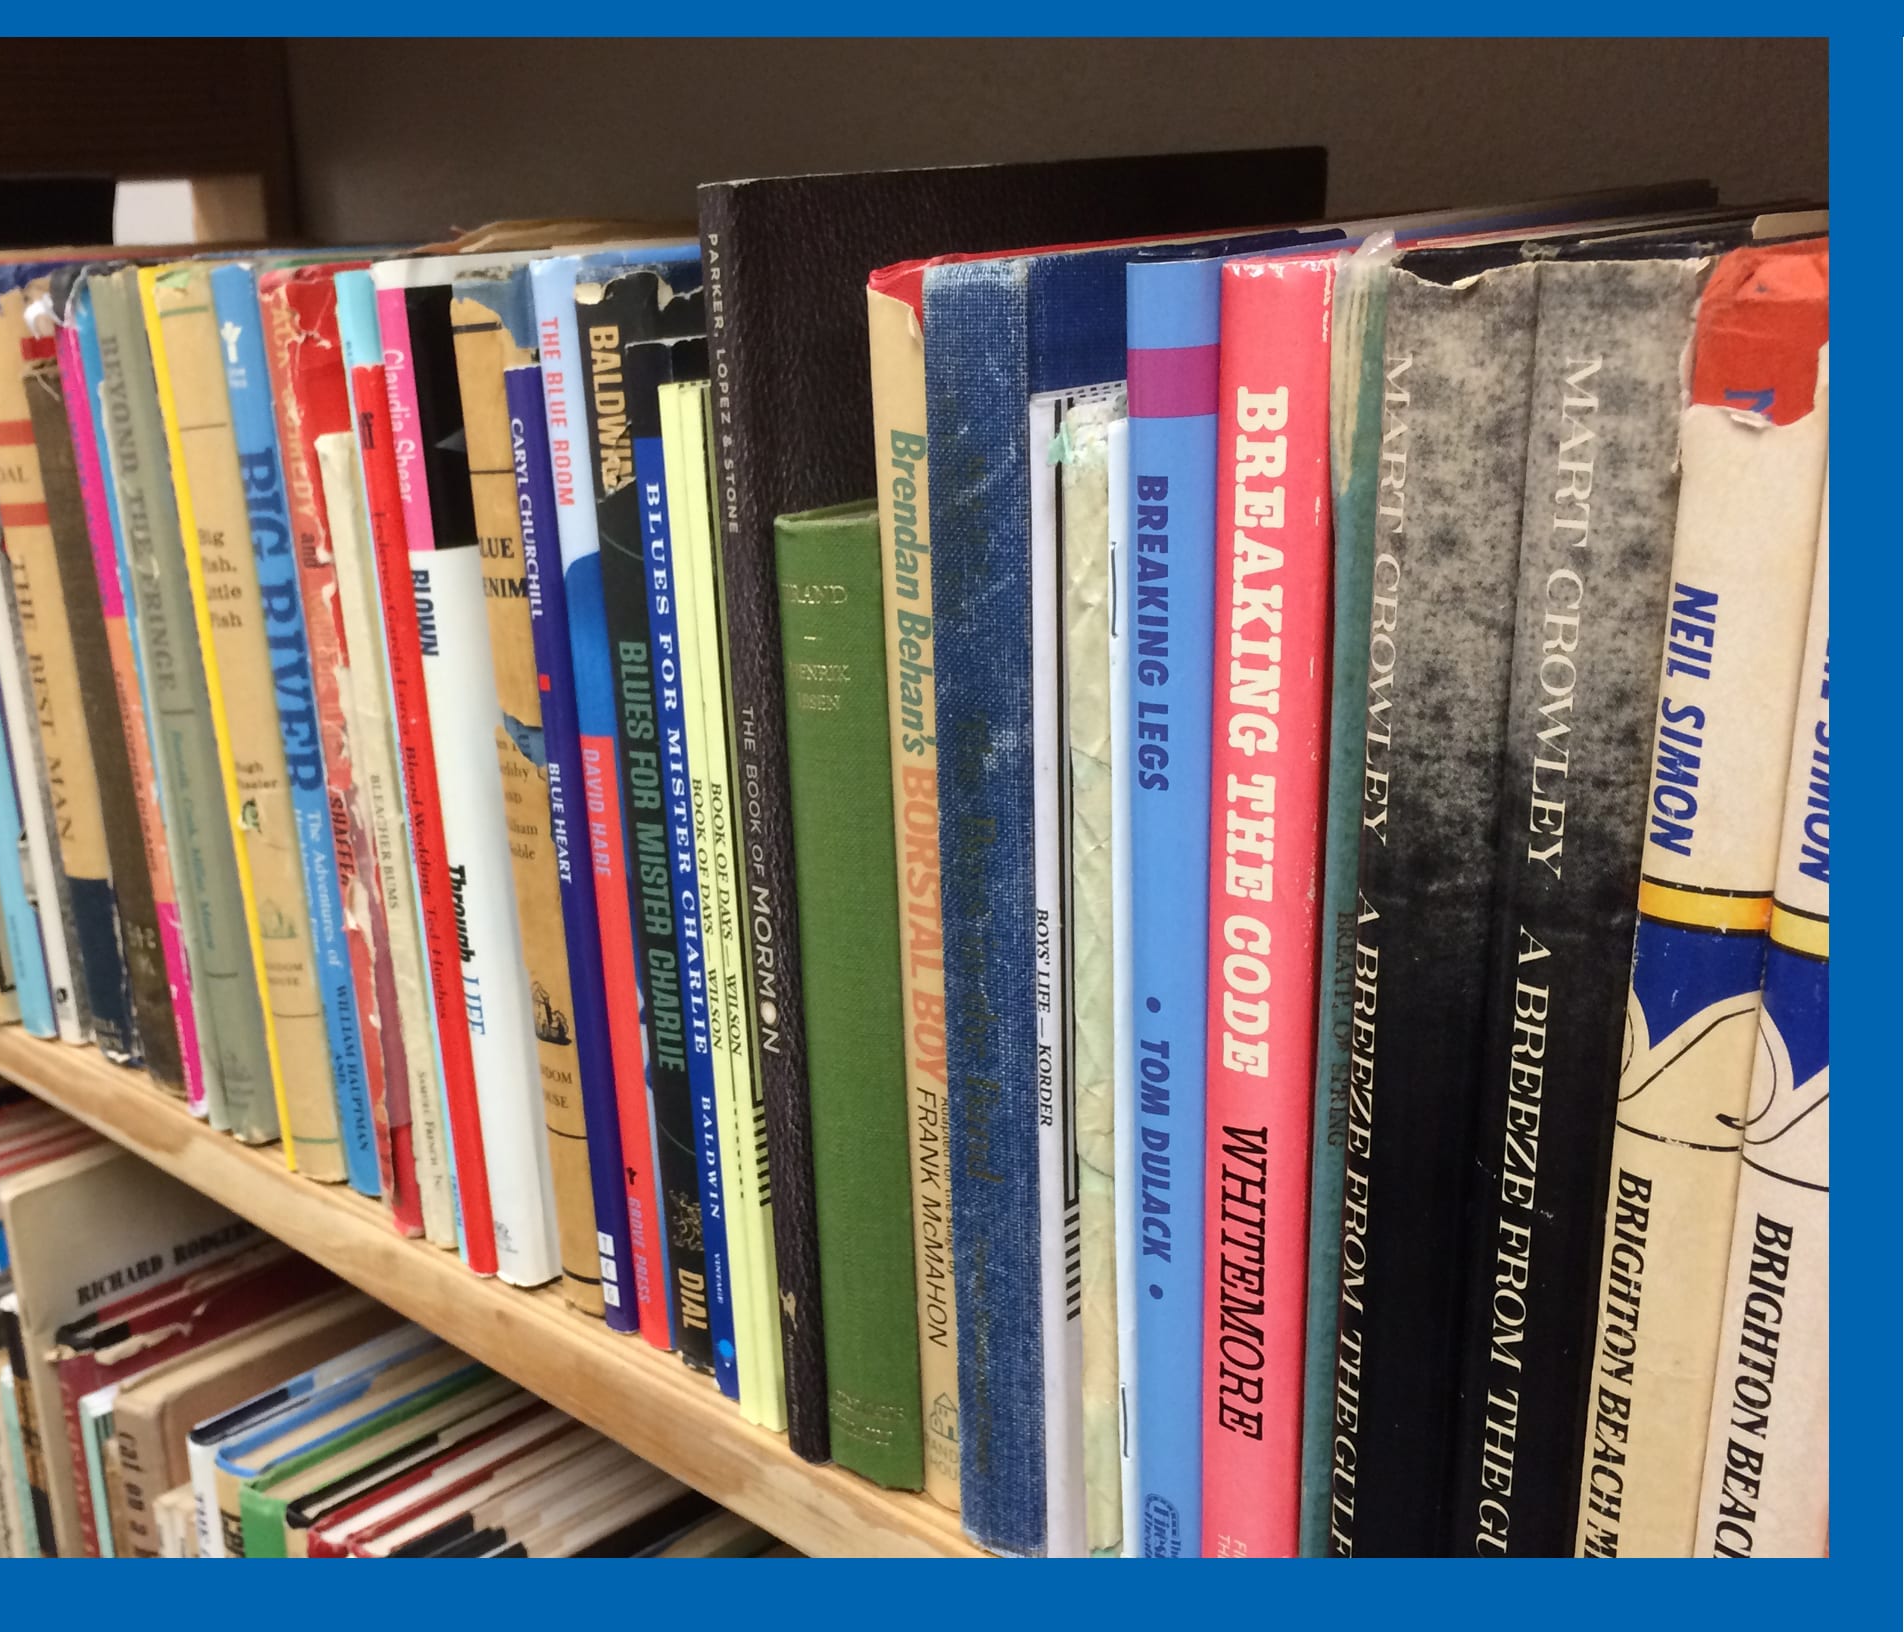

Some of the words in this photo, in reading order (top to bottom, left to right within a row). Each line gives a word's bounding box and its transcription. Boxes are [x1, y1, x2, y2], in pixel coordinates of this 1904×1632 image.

[510, 418, 531, 490] CARYL
[1553, 356, 1604, 547] MART
[519, 494, 544, 620] CHURCHILL
[1137, 475, 1170, 686] BREAKING
[1229, 386, 1291, 755] BREAKING
[1666, 583, 1720, 680] NEIL
[548, 763, 564, 814] BLUE
[1137, 696, 1170, 792] LEGS
[1526, 568, 1584, 880] CROWLEY
[1649, 698, 1706, 857] SIMON
[554, 818, 572, 884] HEART
[1226, 774, 1277, 902] THE
[1222, 915, 1272, 1079] CODE
[1140, 1039, 1170, 1116] TOM
[1142, 1126, 1172, 1263] DULACK
[1219, 1126, 1268, 1442] WHITEMORE
